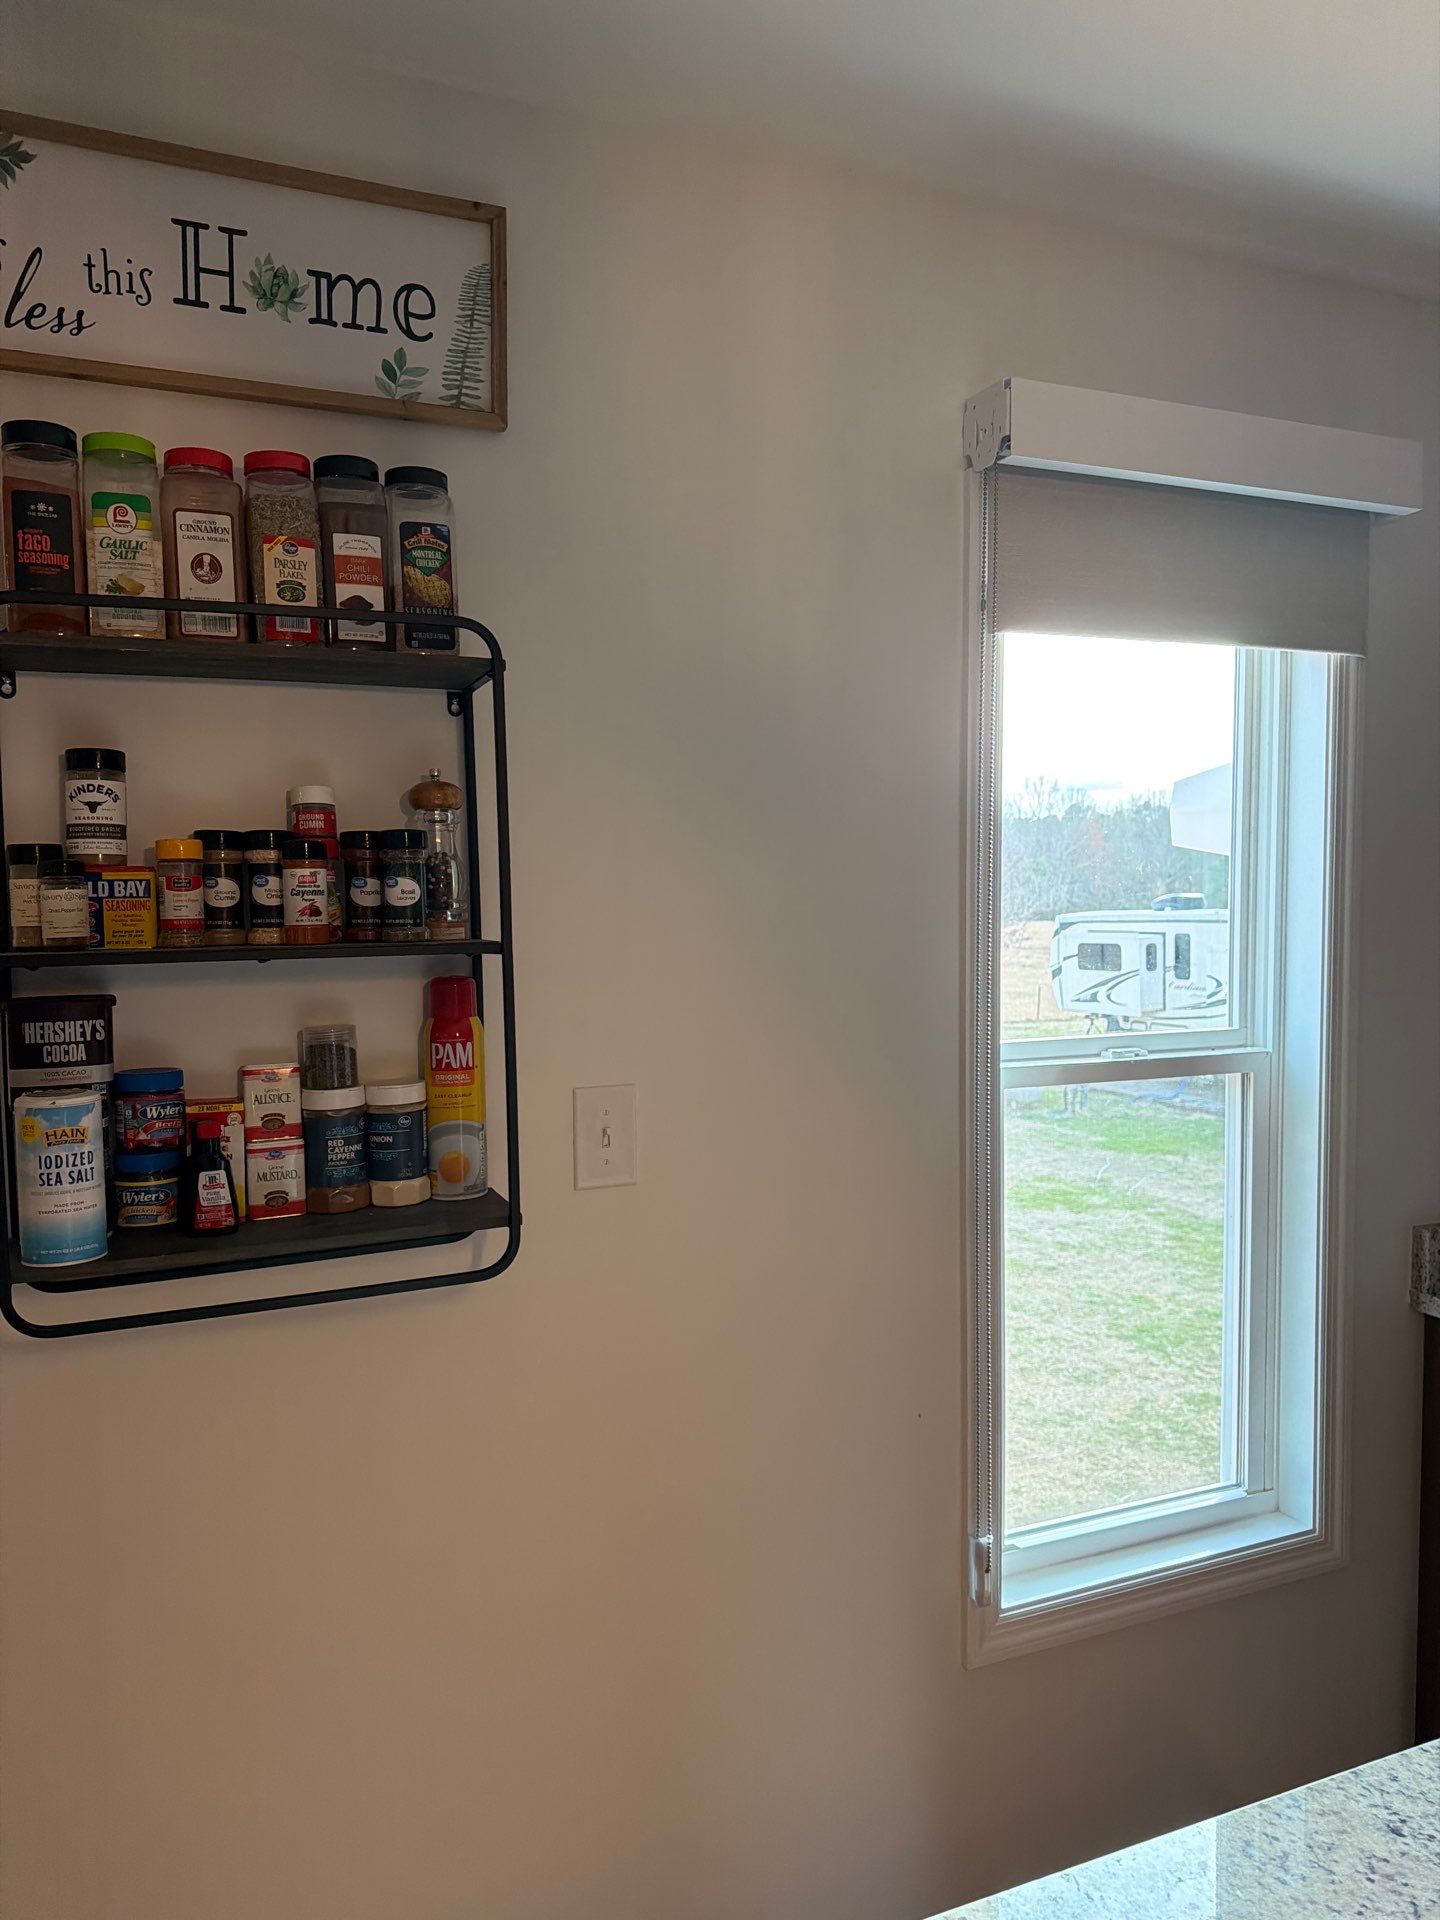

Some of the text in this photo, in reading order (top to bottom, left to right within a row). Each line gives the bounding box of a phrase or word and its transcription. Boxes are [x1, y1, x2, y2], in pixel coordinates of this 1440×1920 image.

[0, 217, 436, 342] less this Hme
[179, 523, 230, 536] CINNAMON
[16, 529, 51, 552] taco
[99, 536, 148, 551] GARLIC
[18, 551, 70, 570] seasoning
[109, 549, 141, 561] SALT
[412, 550, 443, 560] MONTREAL
[273, 557, 308, 571] PARSLEY
[346, 564, 370, 573] CHILI
[415, 558, 441, 568] CHICKEN
[279, 569, 304, 580] FLAKES
[339, 572, 379, 583] POWDER
[68, 783, 120, 803] KINDER'S
[299, 813, 324, 821] GROUND
[299, 820, 325, 829] CUMIN
[87, 880, 147, 898] LD BAY
[290, 888, 325, 898] Cayenne
[105, 899, 151, 912] SEASONING
[24, 1018, 106, 1044] HERSHEY'S
[42, 1043, 88, 1064] COCOA
[431, 1041, 473, 1069] PAM
[61, 1069, 87, 1077] CACAO
[435, 1073, 470, 1081] ORIGINAL
[253, 1092, 292, 1105] ALLSPICE
[45, 1128, 86, 1141] HAIN
[327, 1139, 345, 1147] RED
[38, 1150, 94, 1170] IODIZED
[327, 1152, 356, 1161] PEPPER
[38, 1167, 95, 1187] SEA SALT
[256, 1169, 298, 1183] MUSTARD
[121, 1190, 165, 1205] Wyler's
